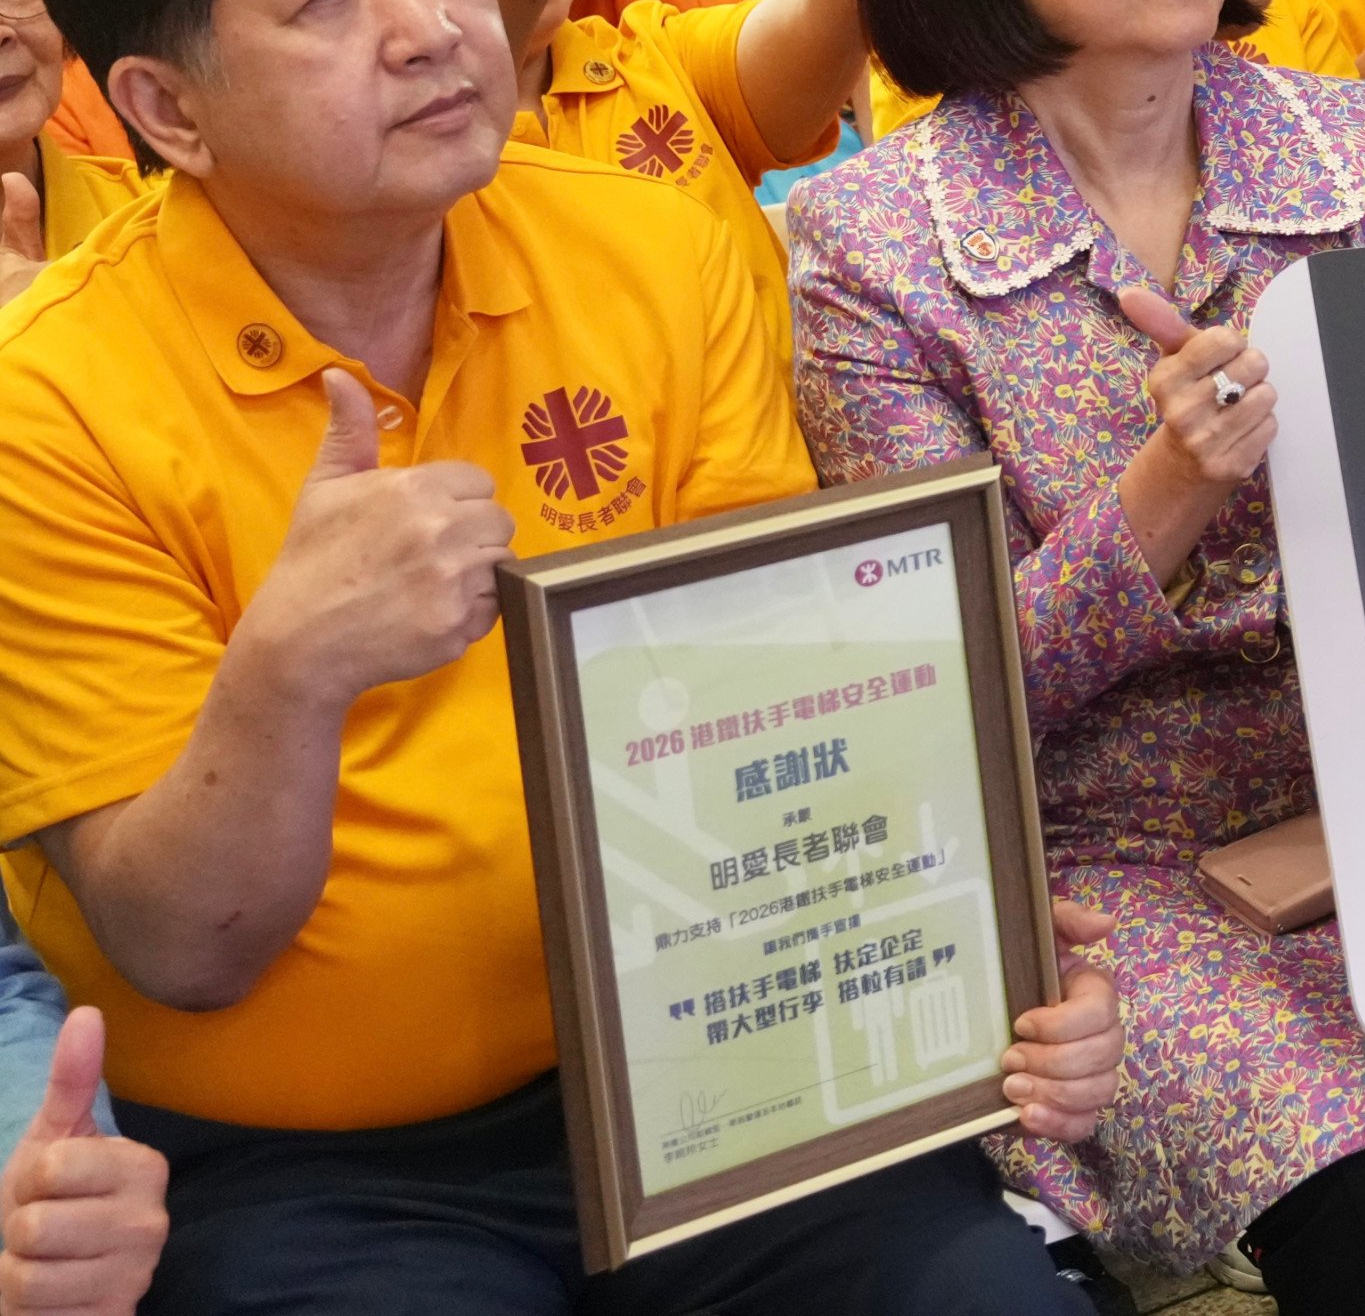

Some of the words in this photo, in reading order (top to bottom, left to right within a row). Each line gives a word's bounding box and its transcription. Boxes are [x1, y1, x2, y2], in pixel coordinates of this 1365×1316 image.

[540, 476, 647, 534] 明愛長者聯會
[886, 547, 944, 579] MTR
[625, 728, 685, 767] 2026
[691, 662, 937, 749] 港鐵扶手電梯安全運動
[735, 737, 852, 803] 感謝狀
[710, 814, 889, 891] 明愛長者聯會
[704, 959, 821, 1016] 搭扶手電梯
[834, 928, 923, 975] 扶定企定
[707, 990, 825, 1046] 帶大型行李
